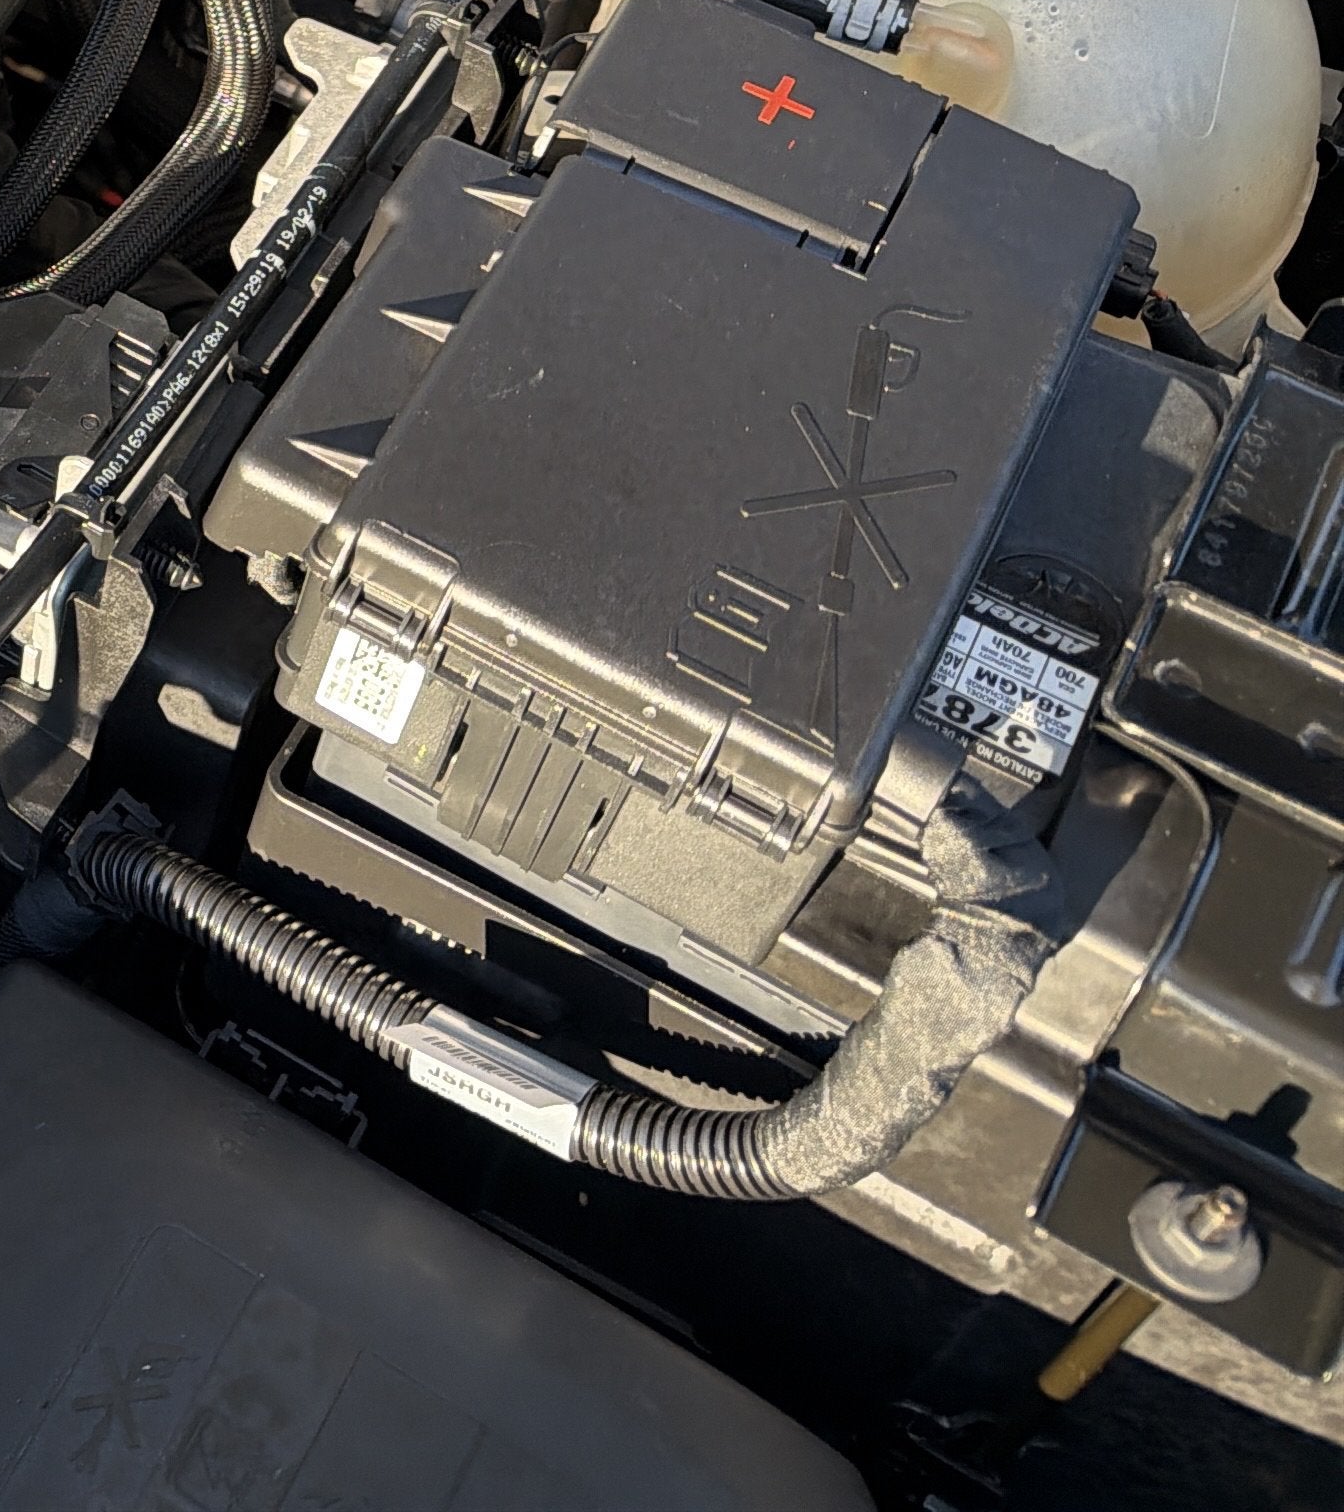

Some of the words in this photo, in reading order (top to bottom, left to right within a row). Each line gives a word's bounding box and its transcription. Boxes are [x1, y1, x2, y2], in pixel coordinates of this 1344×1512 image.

[226, 251, 281, 318] 15:29:19
[276, 186, 328, 250] 19/02/19
[991, 635, 1031, 662] 70Ah
[1055, 666, 1085, 687] 700
[1058, 684, 1075, 694] CCA
[965, 688, 997, 706] MODEL
[974, 666, 1071, 718] 48AGM
[995, 751, 1043, 784] CATALOG
